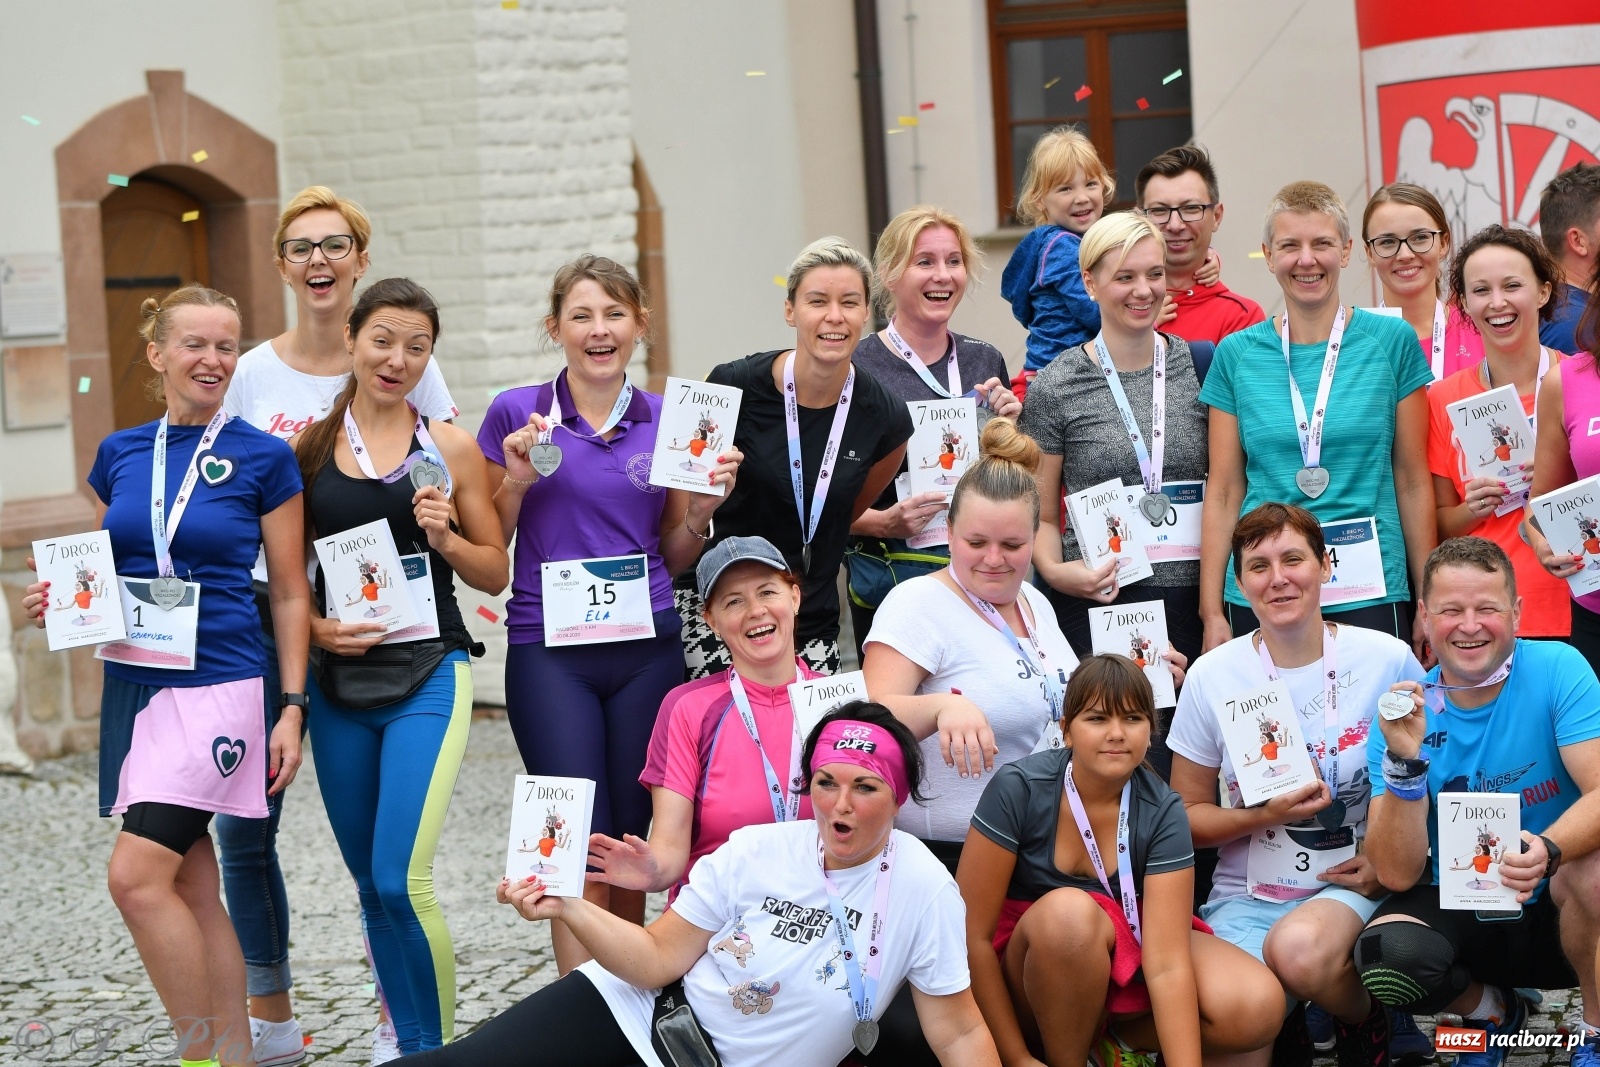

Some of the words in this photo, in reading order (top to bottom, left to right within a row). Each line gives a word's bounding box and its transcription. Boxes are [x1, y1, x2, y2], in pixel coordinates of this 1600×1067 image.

[679, 384, 691, 404] 7
[692, 391, 729, 409] DRÓG
[917, 406, 927, 425] 7
[930, 407, 966, 421] DRÓG
[1458, 407, 1468, 426] 7
[1472, 400, 1507, 420] DRÓG
[1081, 495, 1088, 515] 7
[1092, 490, 1118, 508] DRÓG
[1543, 502, 1553, 522] 7
[1556, 493, 1594, 514] DRÓG
[46, 543, 56, 564] 7
[61, 541, 100, 559] DRÓG
[326, 541, 336, 562] 7
[340, 534, 376, 555] DRÓG
[587, 583, 616, 606] 15
[133, 605, 144, 627] 1
[585, 610, 610, 622] ELA
[1103, 611, 1113, 631] 7
[1117, 611, 1154, 626] DRÓG
[804, 685, 813, 706] 7
[818, 683, 856, 700] DRÓG
[1225, 700, 1236, 721] 7
[1240, 692, 1278, 714] DRÓG
[1423, 730, 1448, 748] 4F
[526, 781, 536, 802] 7
[538, 787, 574, 801] DRÓG
[1522, 777, 1561, 808] RUN
[1450, 802, 1461, 822] 7
[1465, 807, 1506, 820] DRÓG
[1295, 852, 1310, 872] 3
